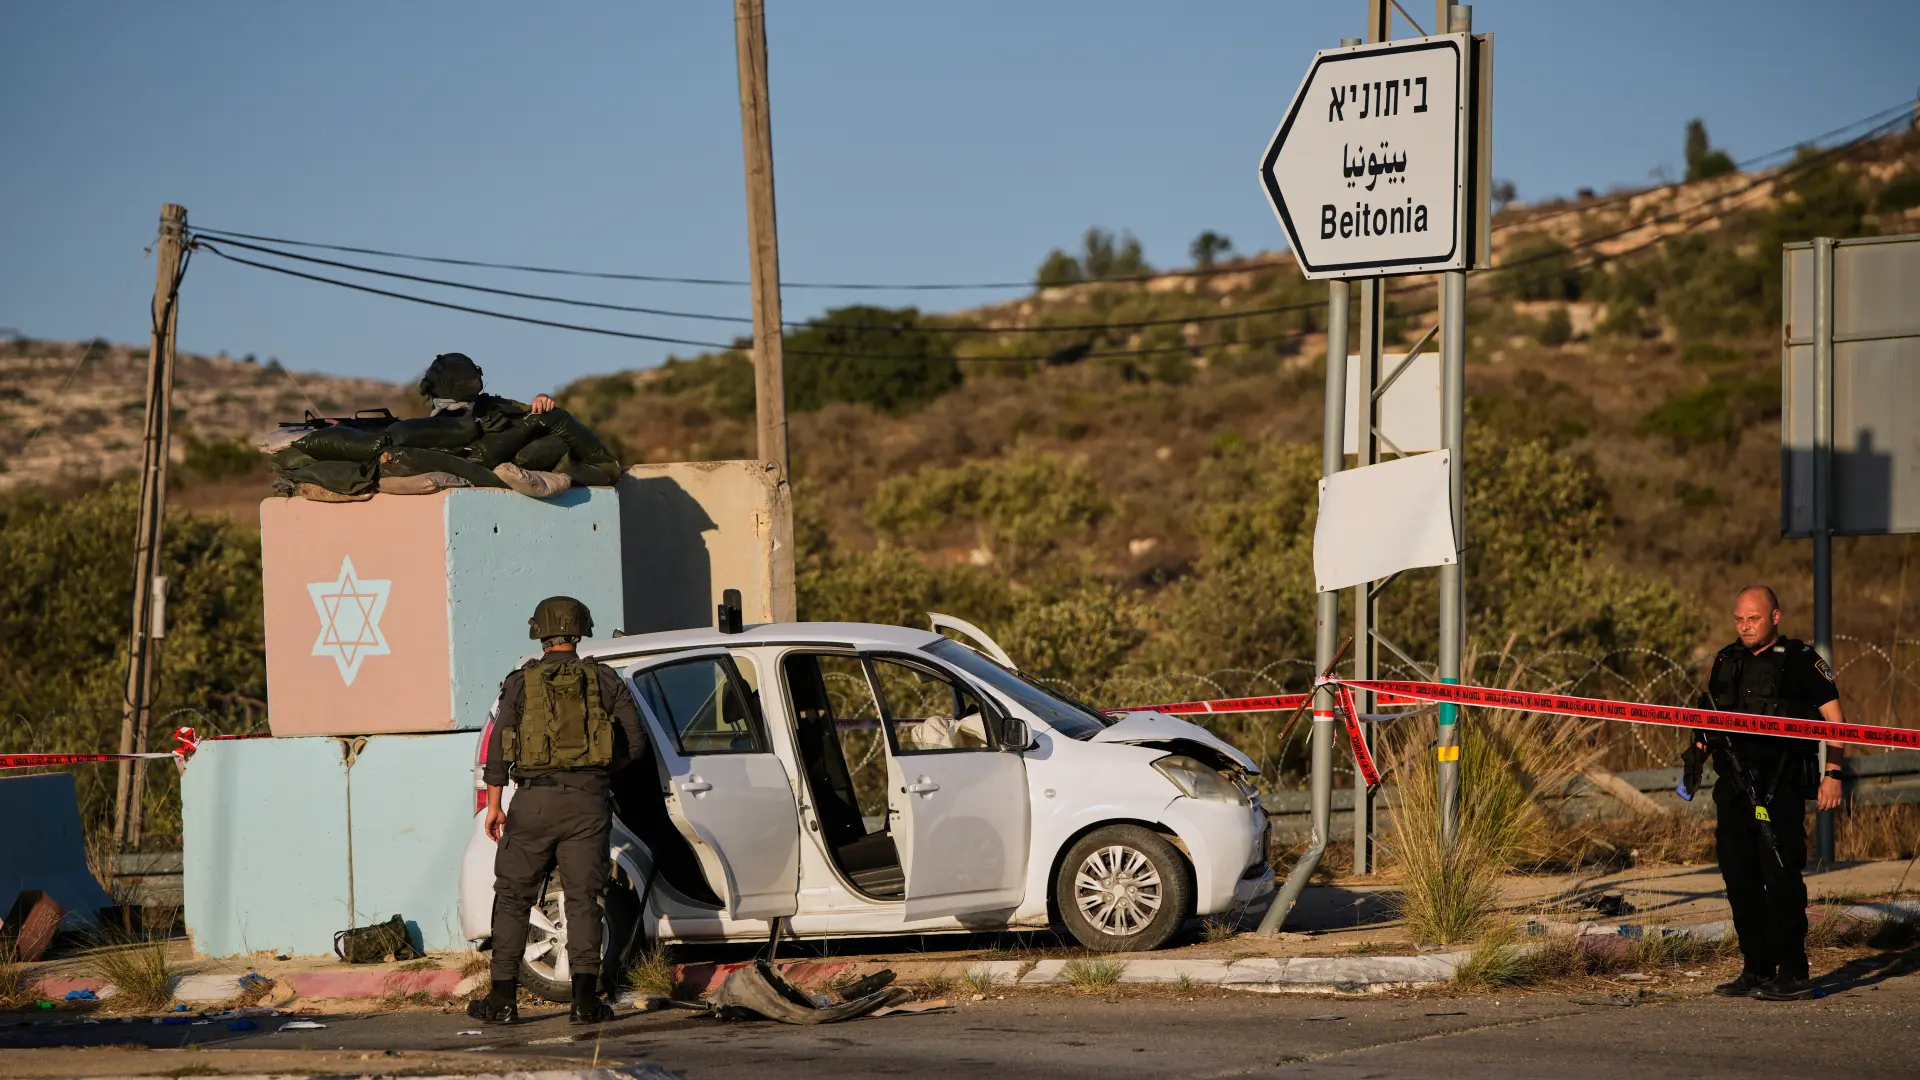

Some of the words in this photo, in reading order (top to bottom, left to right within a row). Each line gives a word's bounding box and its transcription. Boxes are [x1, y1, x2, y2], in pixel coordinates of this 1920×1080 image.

[1329, 76, 1428, 122] ביתוניא
[1342, 141, 1407, 191] بيتونيا
[1321, 197, 1428, 240] Beitonia
